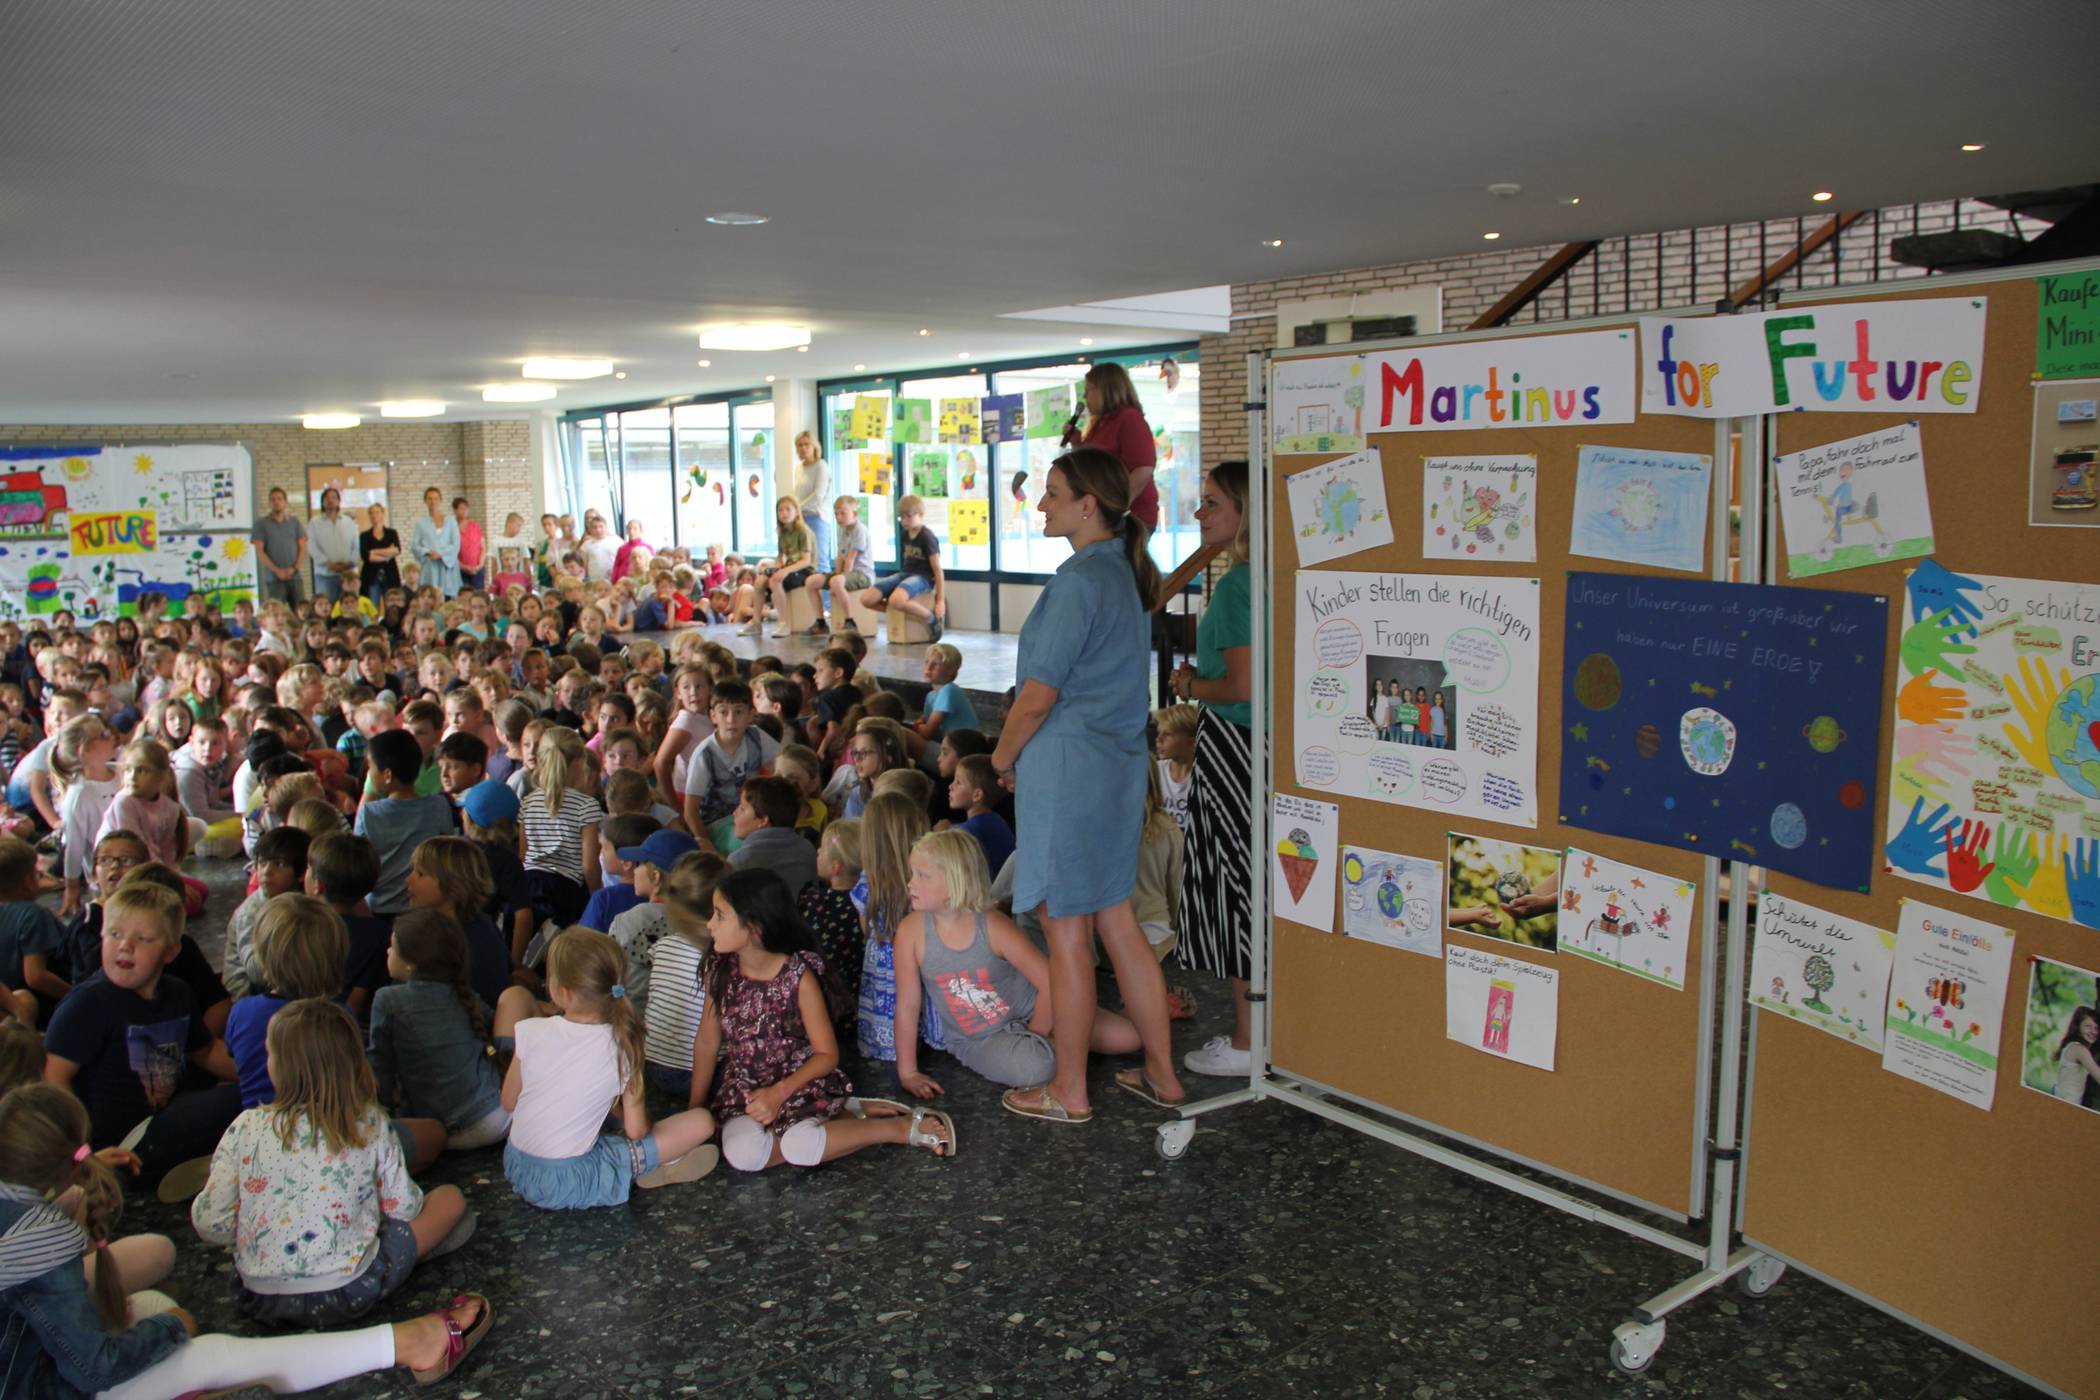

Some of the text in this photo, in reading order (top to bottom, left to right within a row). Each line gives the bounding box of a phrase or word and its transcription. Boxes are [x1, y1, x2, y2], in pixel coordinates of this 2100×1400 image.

[1658, 314, 1972, 408] for Future
[1380, 358, 1601, 427] Martinus
[1851, 437, 1879, 455] doch
[1486, 462, 1536, 477] Verpackung
[1798, 470, 1811, 483] mit
[1813, 465, 1837, 480] dem
[1898, 452, 1919, 464] zum
[71, 515, 156, 550] FUTURE
[1306, 576, 1532, 643] Kinder stellen die richtigen
[1571, 583, 1620, 607] Unser
[1626, 586, 1714, 614] Universum
[1721, 600, 1739, 616] ist
[1830, 619, 1859, 635] wir
[1982, 585, 2009, 613] So
[1373, 619, 1430, 656] Fragen
[1616, 629, 1655, 648] haben
[1660, 639, 1686, 651] nur
[1692, 637, 1737, 660] EINE
[1764, 918, 1837, 958] Umwelt
[1825, 923, 1854, 941] die
[1922, 919, 1949, 937] Gute
[1951, 928, 1992, 951] Einfälle
[1448, 958, 1466, 968] ohne
[1470, 954, 1488, 965] doch
